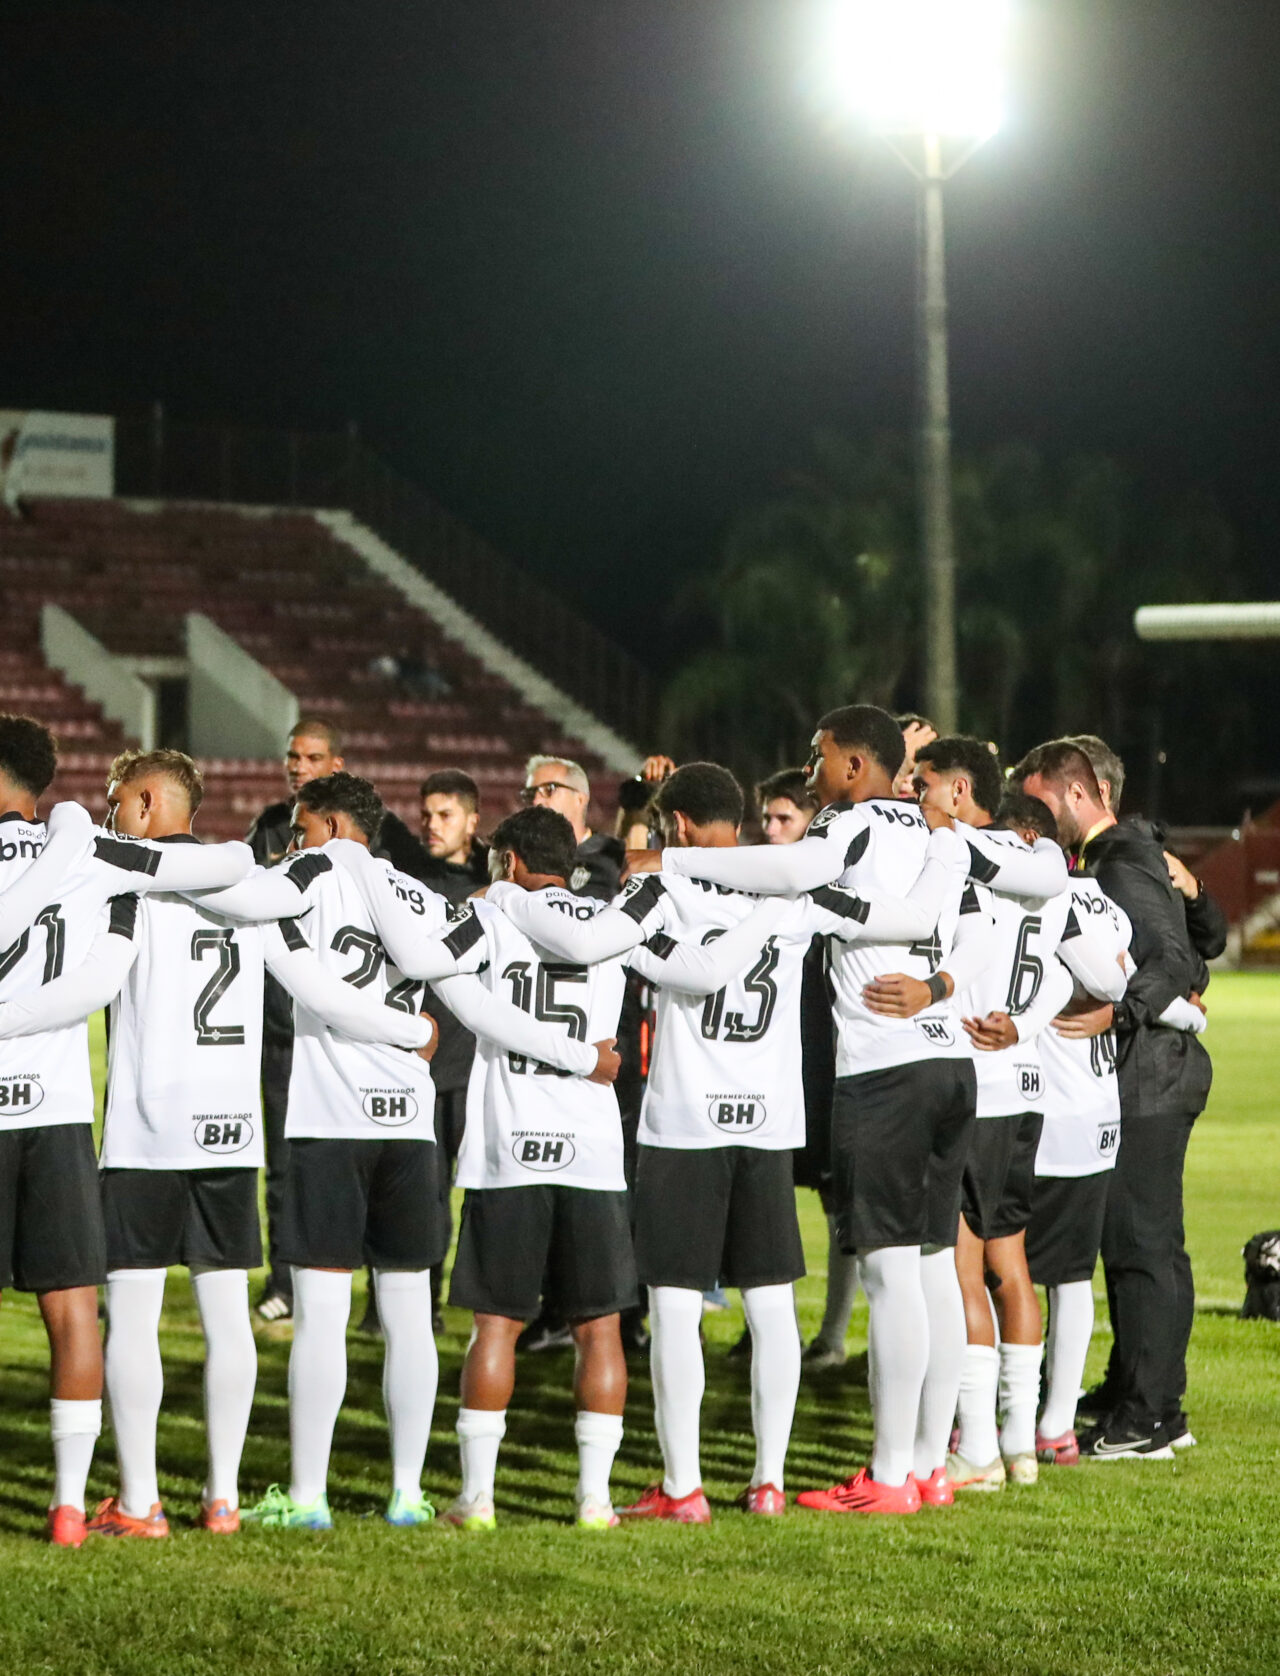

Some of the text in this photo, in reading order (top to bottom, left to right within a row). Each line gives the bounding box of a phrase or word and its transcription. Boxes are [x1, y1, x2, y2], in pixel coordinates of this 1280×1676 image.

[1006, 915, 1043, 1016] 6
[190, 928, 245, 1045] 2
[700, 928, 780, 1042] 13
[501, 960, 588, 1077] 15
[921, 1023, 949, 1040] BH
[1021, 1072, 1040, 1092] BH
[192, 1112, 252, 1120] SUPERMERCADOS
[371, 1097, 407, 1117] BH
[717, 1103, 755, 1124] BH
[203, 1122, 241, 1146] BH
[1100, 1129, 1118, 1149] BH
[521, 1140, 564, 1163] BH
